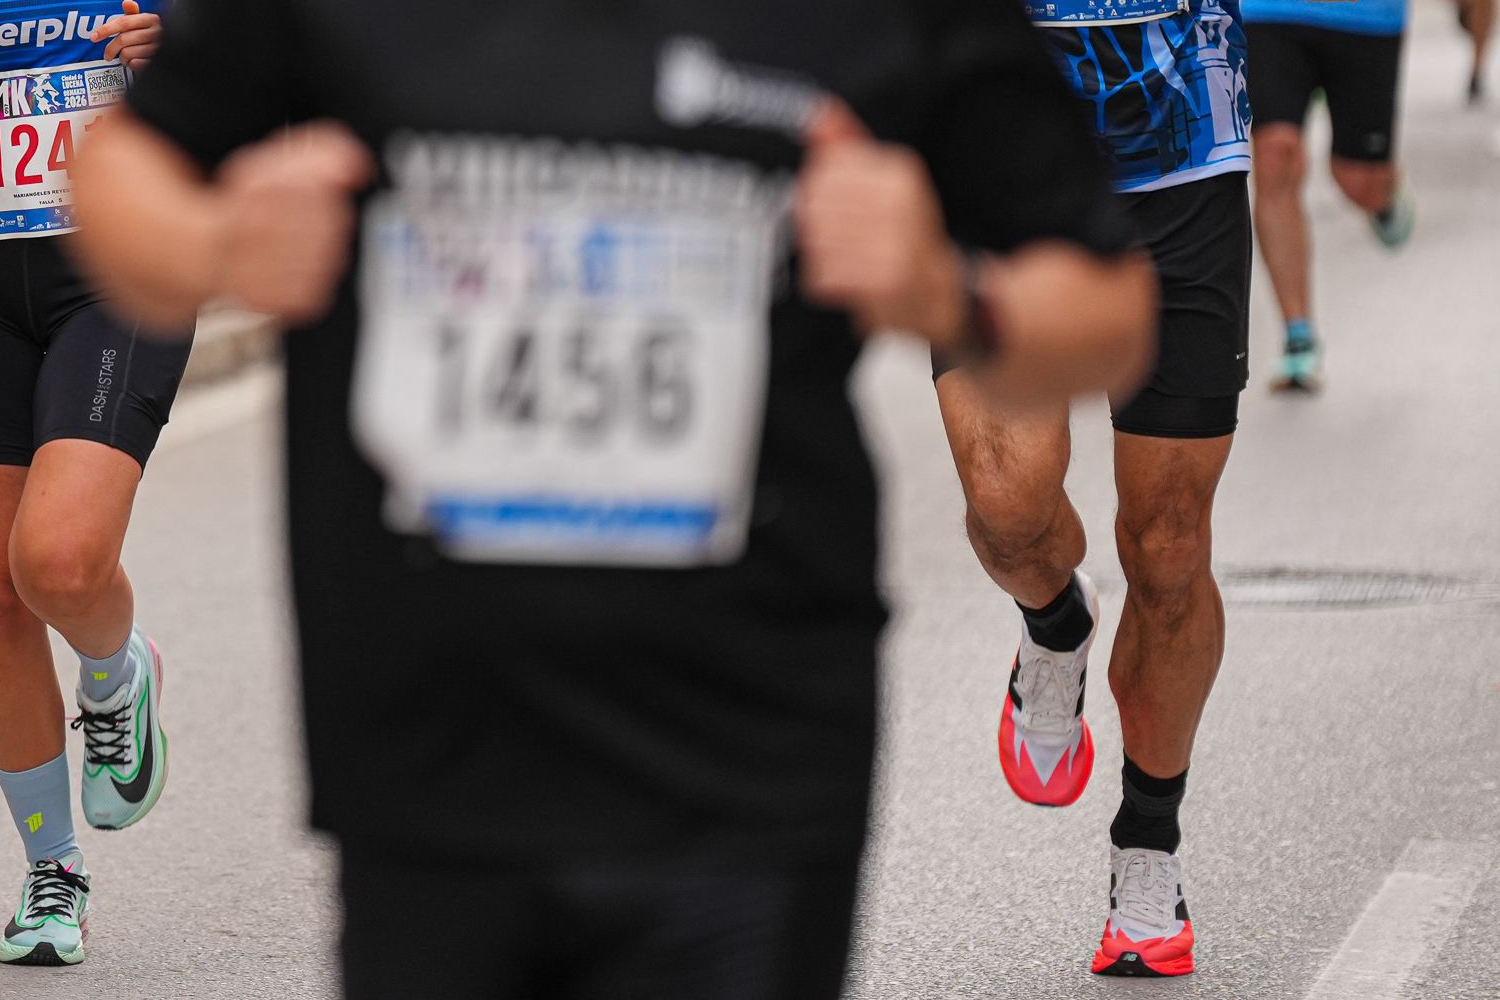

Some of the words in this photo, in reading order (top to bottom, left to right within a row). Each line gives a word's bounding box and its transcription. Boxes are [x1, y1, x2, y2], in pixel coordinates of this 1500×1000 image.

[62, 80, 84, 89] LUCENA
[88, 73, 118, 83] carreras
[89, 79, 124, 91] populares
[64, 95, 87, 109] 2026
[98, 349, 117, 386] STARS
[89, 388, 109, 422] DASH
